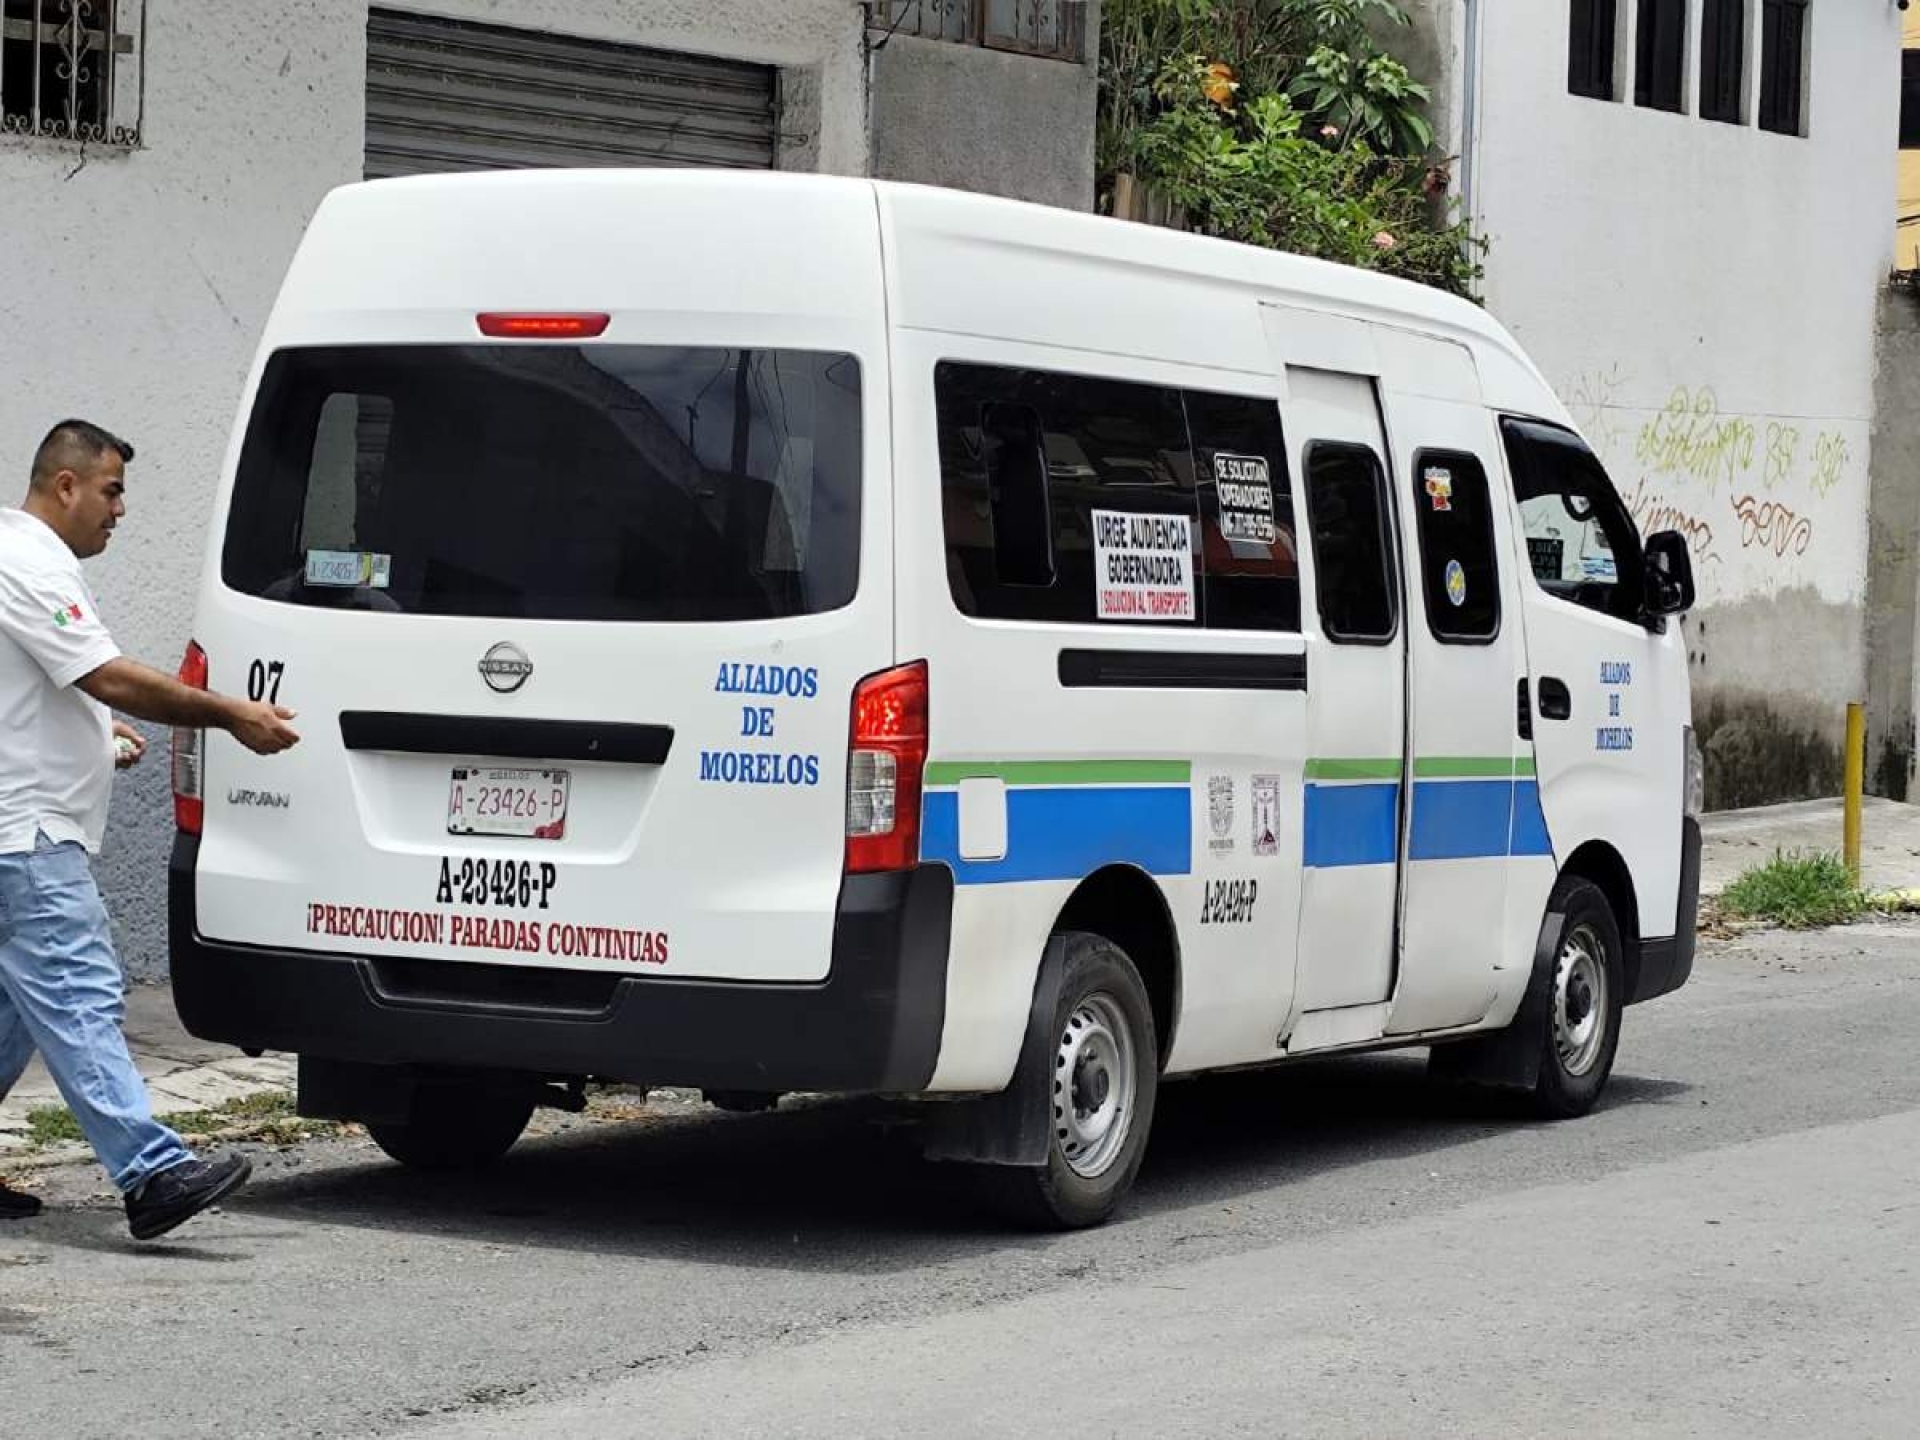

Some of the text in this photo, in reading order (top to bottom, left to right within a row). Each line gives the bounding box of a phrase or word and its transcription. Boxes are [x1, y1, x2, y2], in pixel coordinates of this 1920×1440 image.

[1097, 514, 1128, 547] URGE
[1130, 517, 1187, 551] AUDIENCIA
[1108, 553, 1182, 584] GOBERNADORA
[1137, 590, 1147, 614] AL
[247, 658, 285, 705] 07
[715, 662, 818, 697] ALIADOS
[1600, 661, 1631, 685] ALIADOS
[741, 706, 774, 737] DE
[1609, 693, 1619, 717] DE
[1596, 726, 1633, 750] MORELOS
[699, 751, 819, 785] MORELOS
[228, 787, 290, 808] URVAN
[452, 784, 563, 819] A-23426-P
[437, 855, 557, 910] A-23426-P
[1200, 879, 1257, 924] A-23426-P
[307, 902, 668, 964] ¡PRECAUCION! PARADAS CONTINUAS
